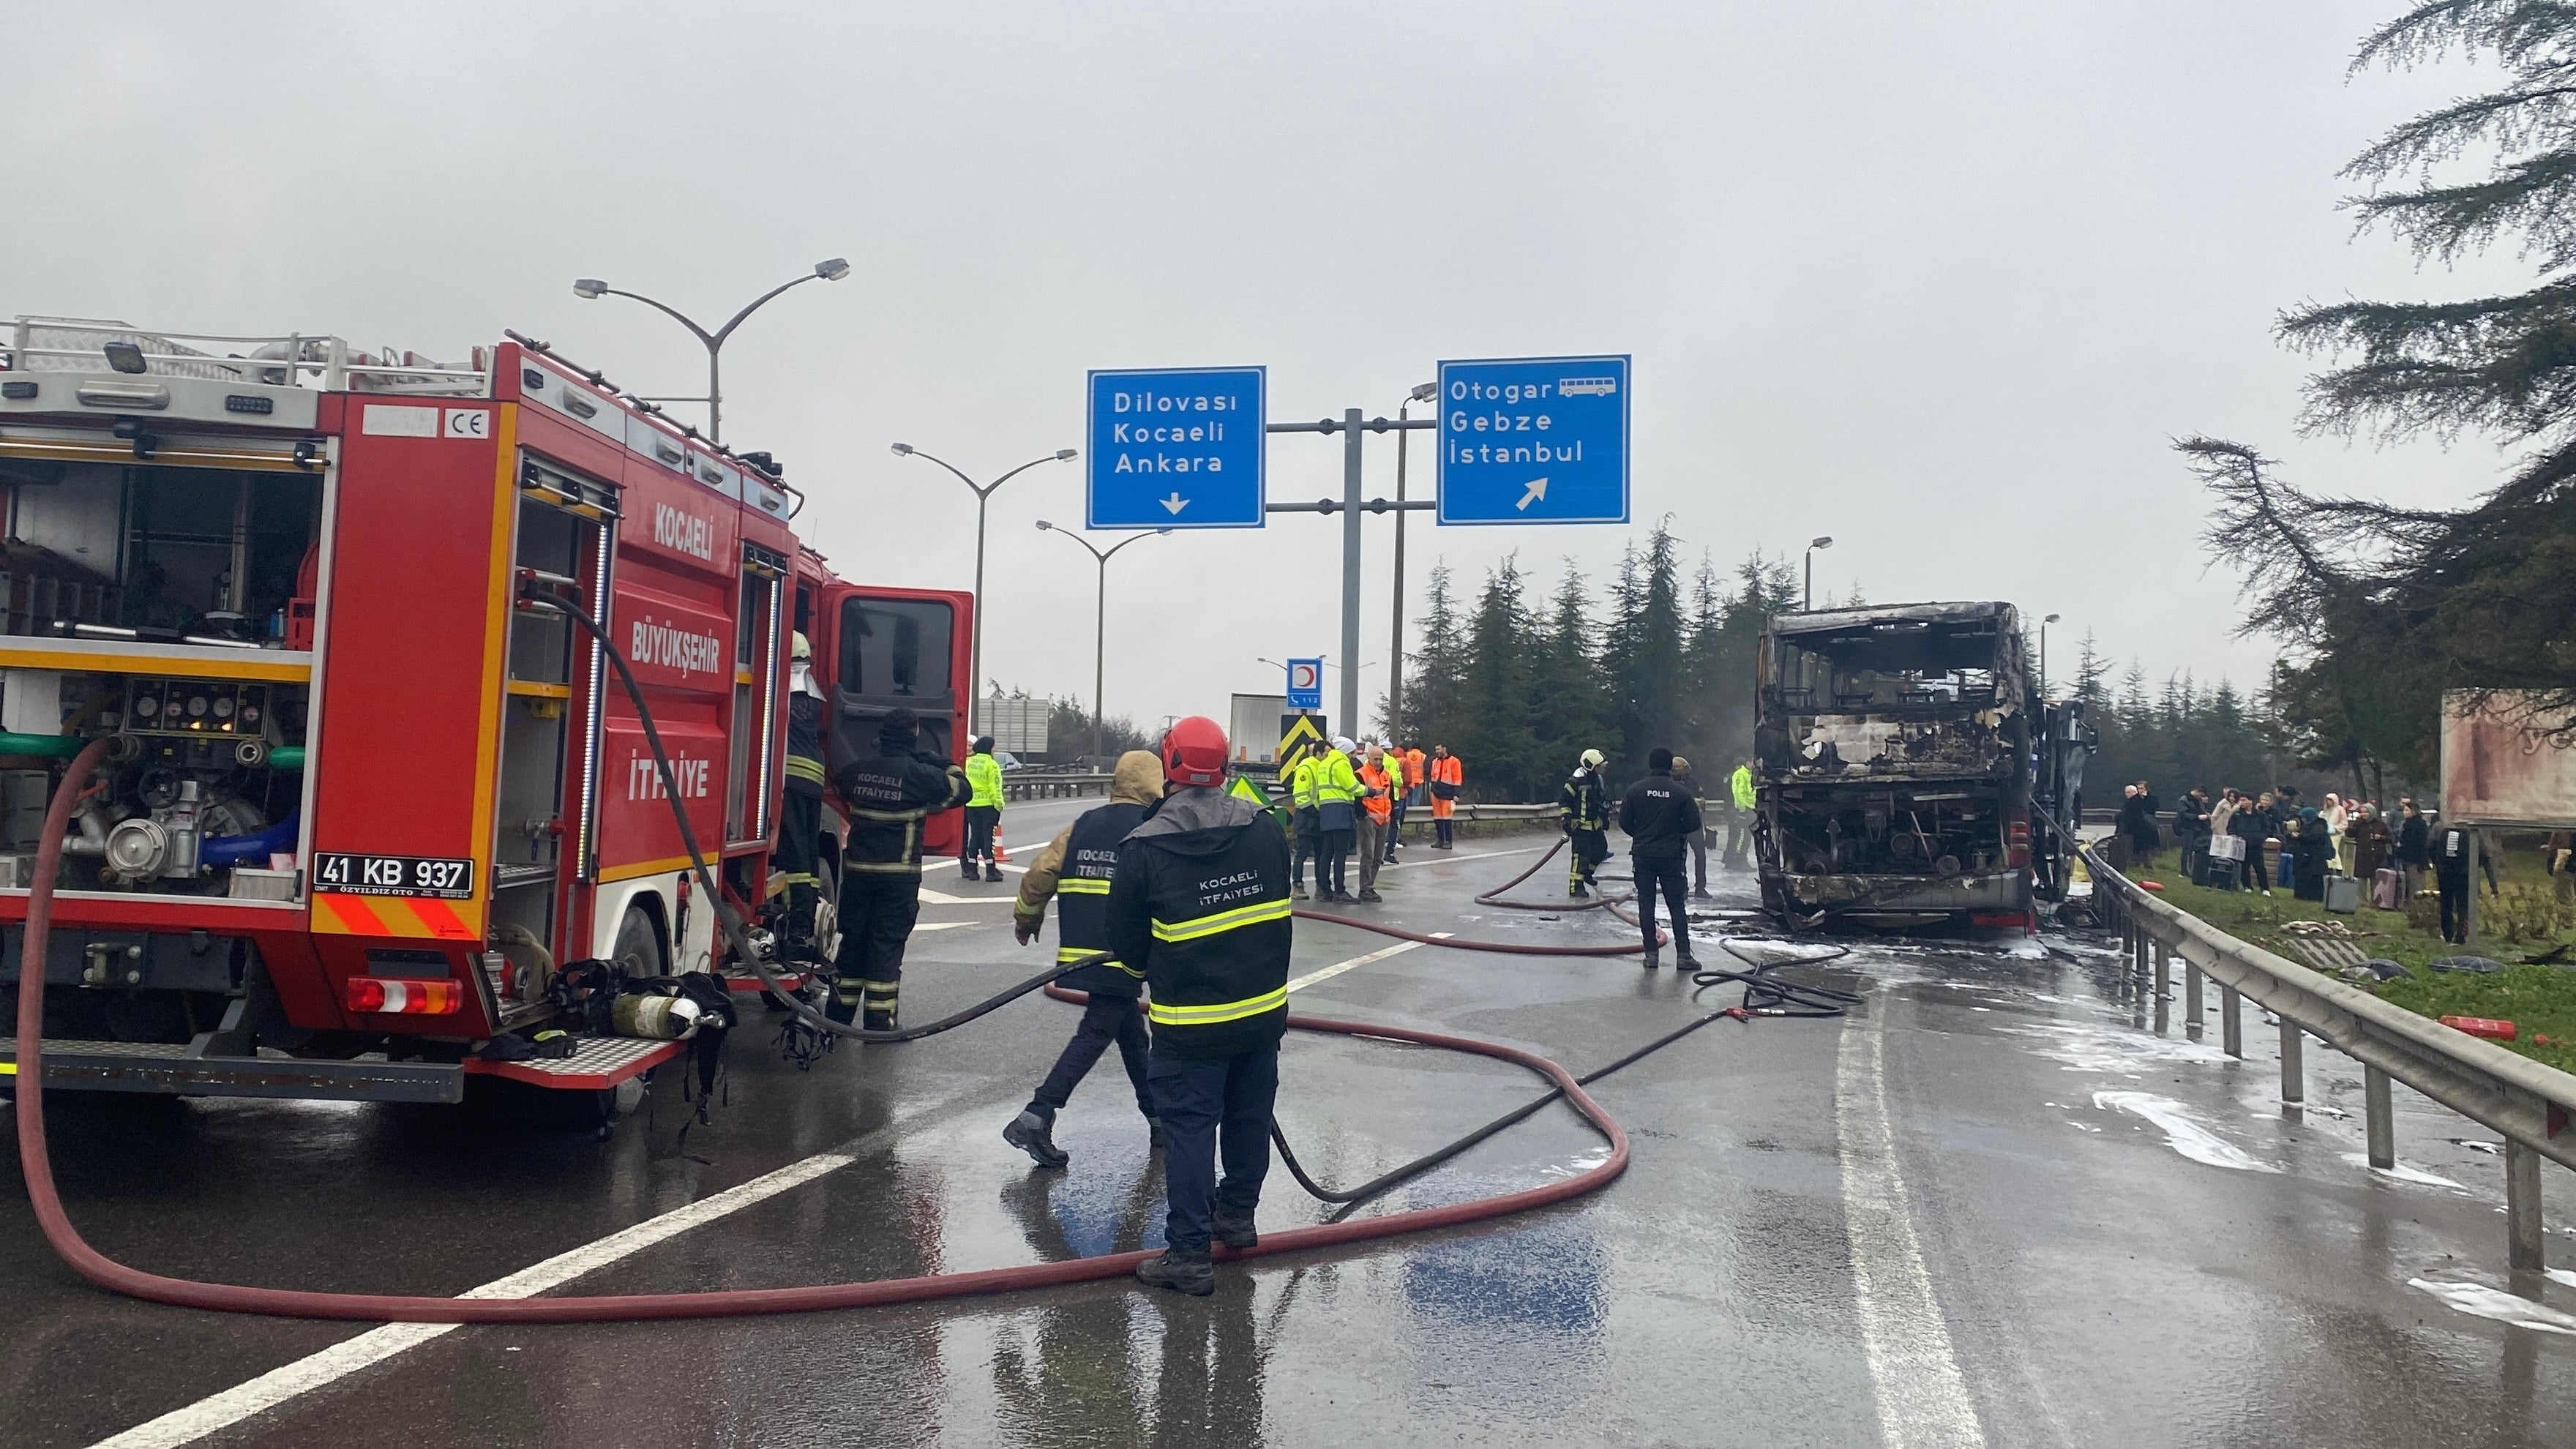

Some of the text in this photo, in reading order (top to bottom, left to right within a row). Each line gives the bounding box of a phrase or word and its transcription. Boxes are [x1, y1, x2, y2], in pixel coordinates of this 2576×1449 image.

[1115, 392, 1237, 413] Dilovası
[1450, 381, 1552, 404] Otogar
[452, 413, 482, 435] CE
[1114, 421, 1224, 443] Kocaeli
[1450, 410, 1551, 433] Gebze
[1115, 452, 1222, 473] Ankara
[1450, 438, 1581, 464] İstanbul
[654, 501, 714, 561] KOCAELİ
[632, 615, 720, 679] BÜYÜKŞEHİR
[323, 857, 464, 888] 41 KB 937
[1199, 869, 1258, 891] KOCAELİ
[1199, 883, 1264, 906] İTFAİYESİ
